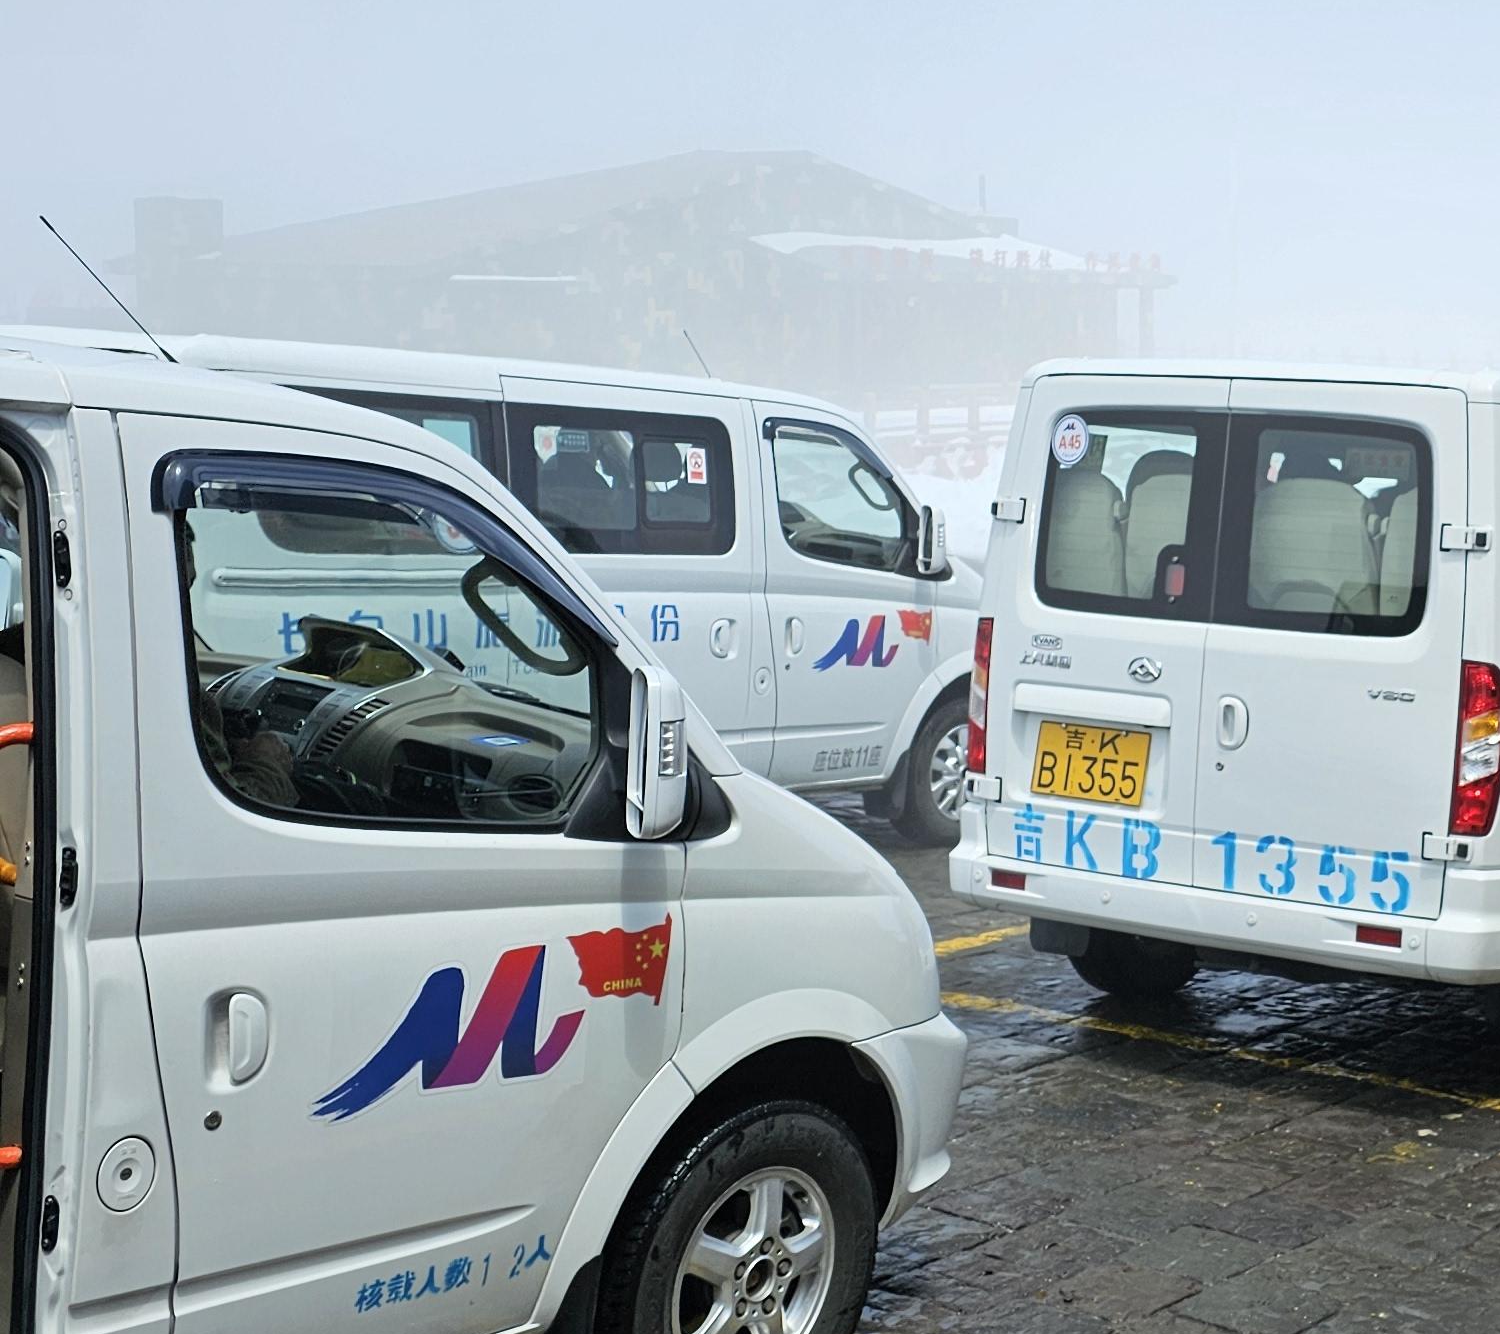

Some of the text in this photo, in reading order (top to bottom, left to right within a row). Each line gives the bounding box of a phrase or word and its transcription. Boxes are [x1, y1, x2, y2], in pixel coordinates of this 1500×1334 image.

[1058, 434, 1082, 450] A45
[1037, 750, 1139, 800] B1355
[603, 976, 643, 992] CHINA
